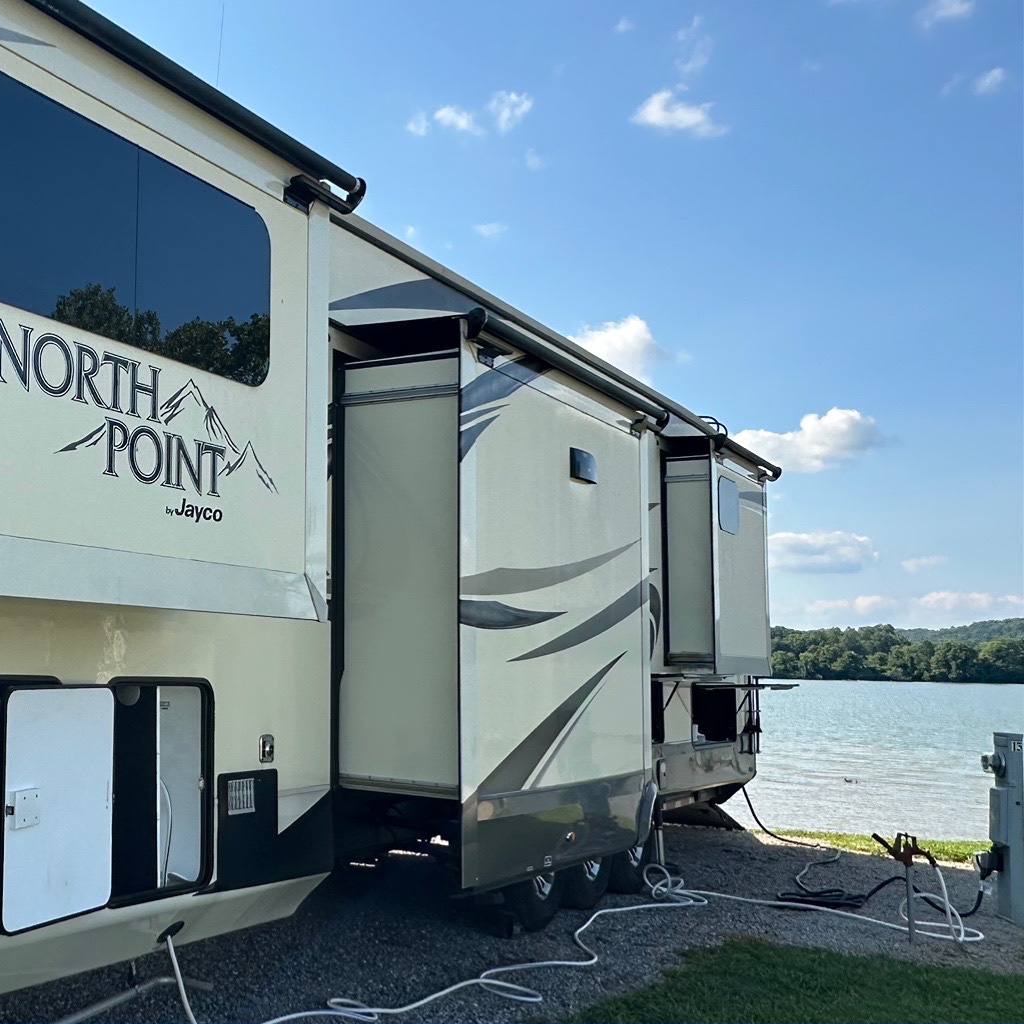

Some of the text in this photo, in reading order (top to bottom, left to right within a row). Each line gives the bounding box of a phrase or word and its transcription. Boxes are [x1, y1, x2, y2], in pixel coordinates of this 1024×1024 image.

[102, 416, 227, 498] POINT
[165, 498, 223, 523] by Jayco
